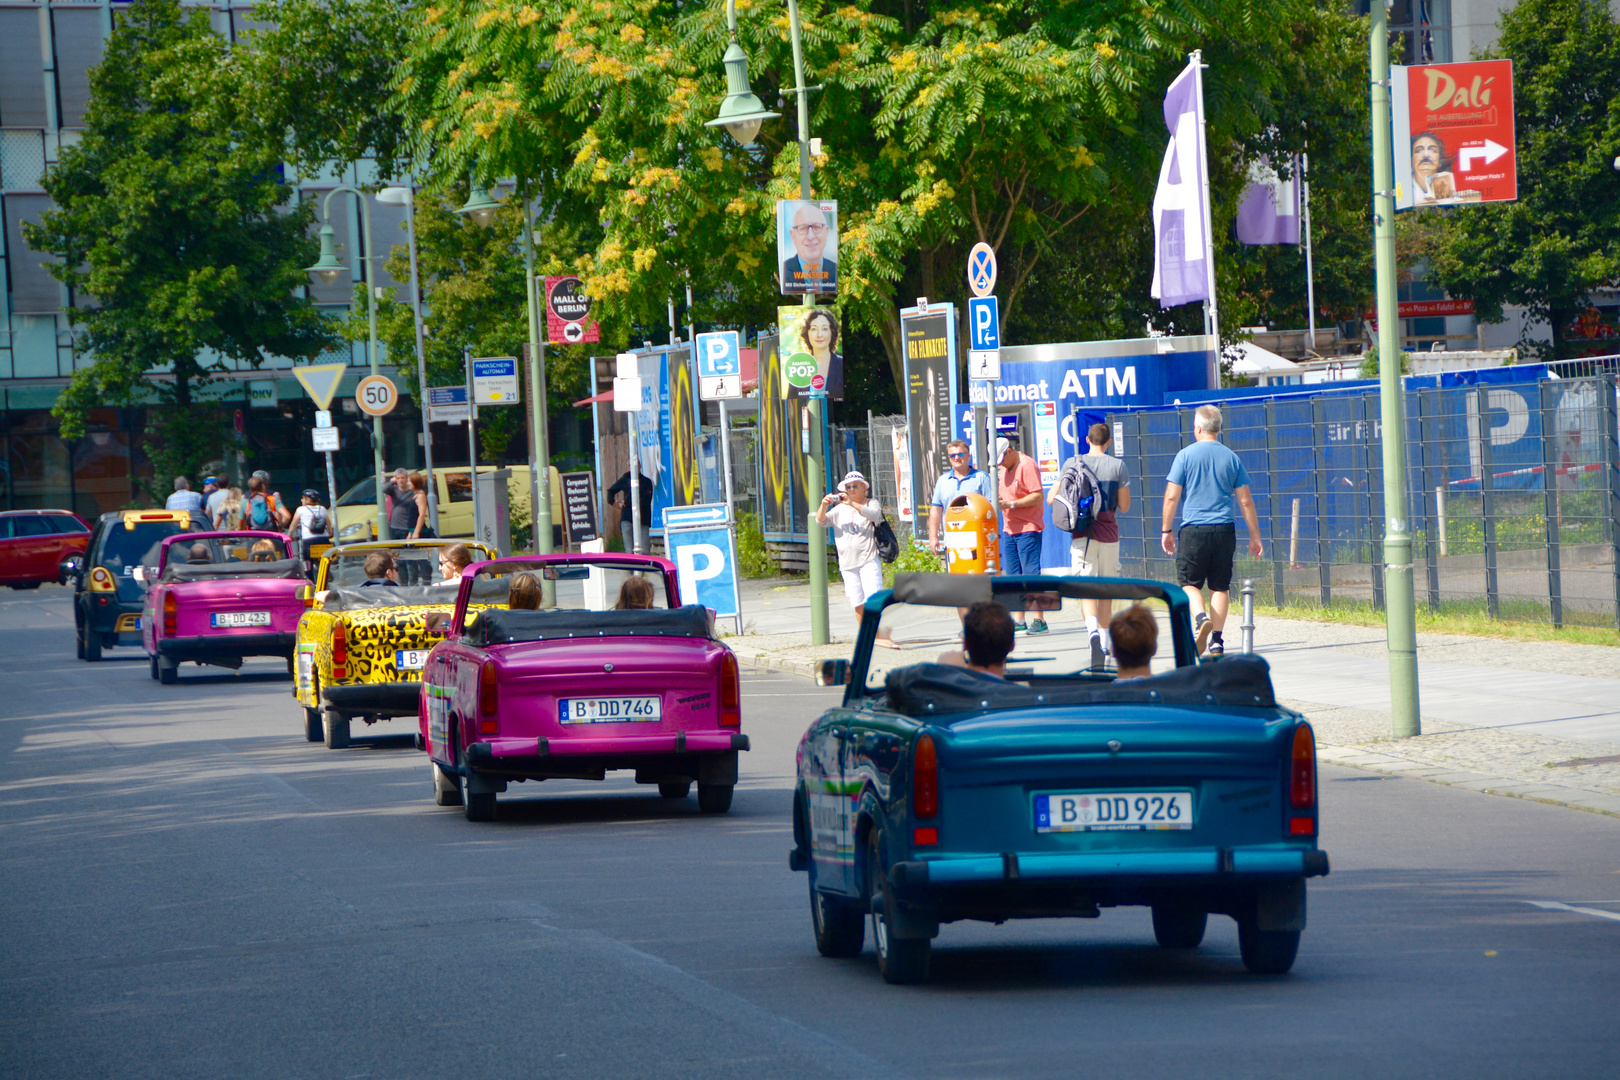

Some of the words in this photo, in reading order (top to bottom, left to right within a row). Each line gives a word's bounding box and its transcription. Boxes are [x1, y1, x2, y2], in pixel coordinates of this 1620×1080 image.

[1423, 68, 1495, 111] Dalí
[803, 263, 821, 271] KURT
[793, 271, 829, 279] WANSNER
[553, 295, 576, 304] MALL
[558, 304, 587, 313] BERLIN
[1413, 303, 1428, 312] Pizza
[1436, 303, 1455, 311] Falafel
[976, 304, 992, 345] P
[706, 338, 729, 371] P
[788, 365, 816, 378] POP
[1058, 366, 1137, 399] ATM
[251, 389, 273, 399] DKV
[366, 386, 388, 404] 50
[505, 392, 516, 400] 21
[676, 543, 725, 605] P
[219, 614, 226, 624] B
[233, 613, 246, 623] DD
[248, 612, 266, 622] 423
[409, 652, 418, 665] B
[575, 701, 587, 717] B
[598, 700, 620, 717] DD
[622, 699, 653, 716] 746
[1060, 798, 1077, 822] B
[1096, 797, 1129, 821] DD
[1134, 796, 1181, 821] 926
